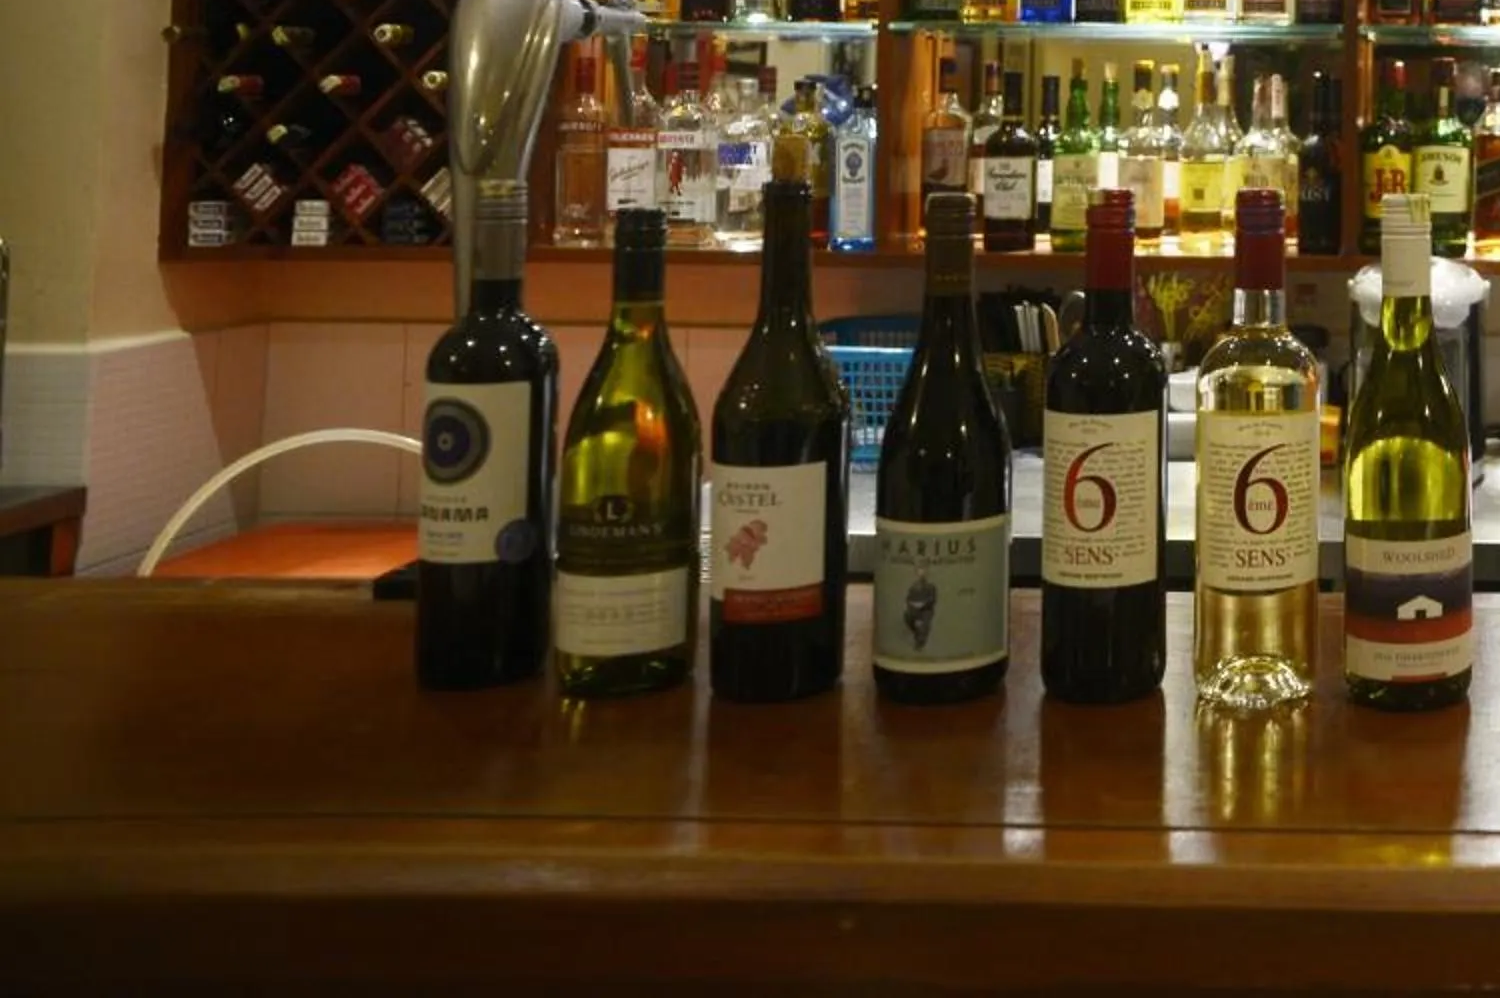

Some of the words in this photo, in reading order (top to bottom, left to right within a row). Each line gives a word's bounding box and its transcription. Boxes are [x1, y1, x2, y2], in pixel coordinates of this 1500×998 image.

[1063, 442, 1117, 533] 6
[1234, 443, 1289, 534] 6
[1064, 545, 1114, 567] SENS
[1235, 547, 1287, 569] SENS
